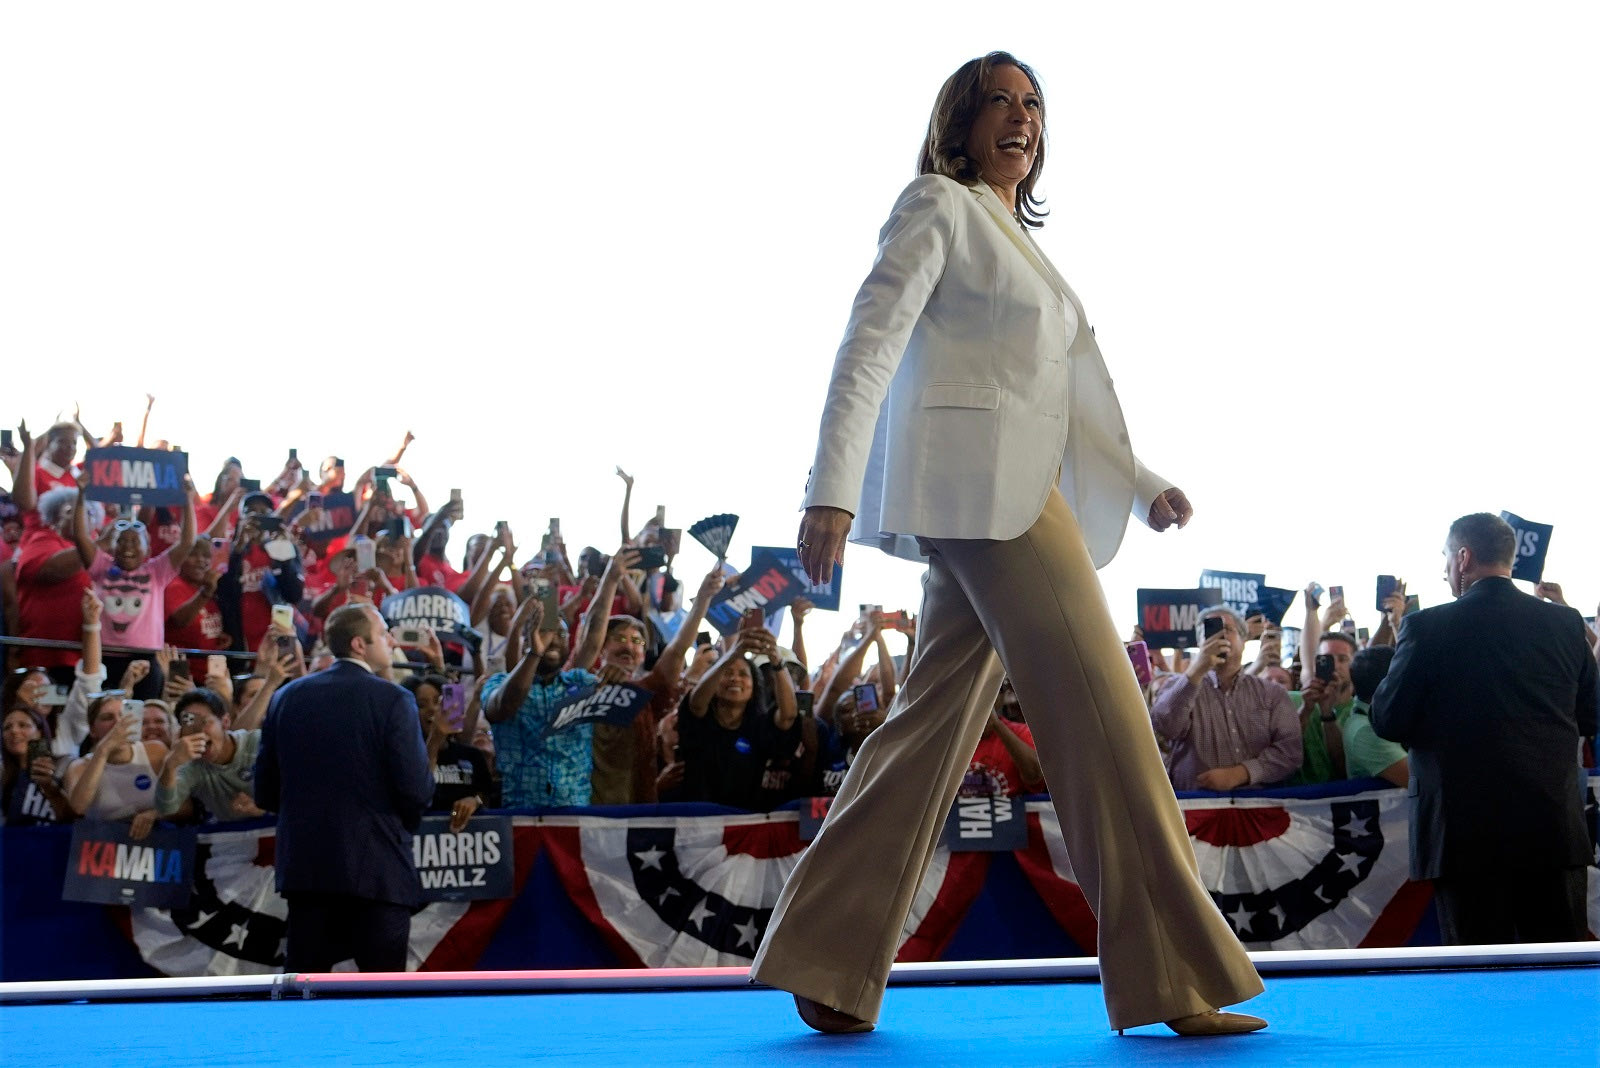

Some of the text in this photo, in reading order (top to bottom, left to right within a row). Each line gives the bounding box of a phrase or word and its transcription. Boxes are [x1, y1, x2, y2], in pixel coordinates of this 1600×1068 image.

[92, 459, 179, 490] KAMALA
[387, 594, 465, 624] HARRIS
[77, 841, 183, 884] KAMALA
[419, 868, 487, 889] WALZ
